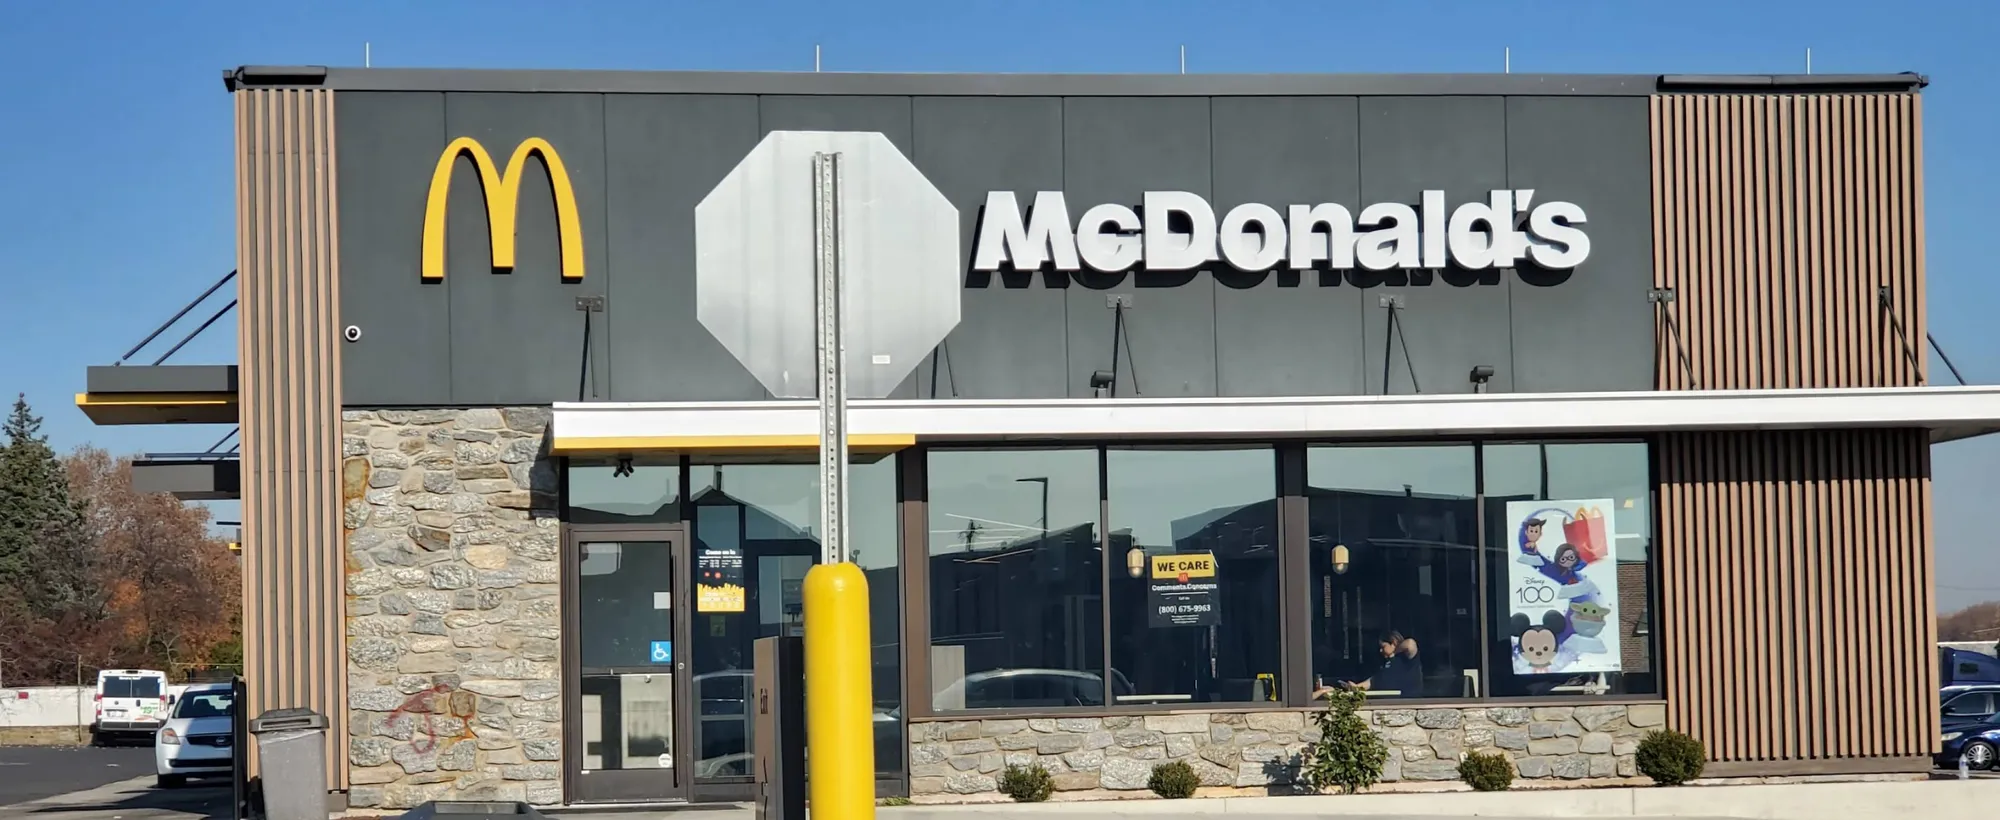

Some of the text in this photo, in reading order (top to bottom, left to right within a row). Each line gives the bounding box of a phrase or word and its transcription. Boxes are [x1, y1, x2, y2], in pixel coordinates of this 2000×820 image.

[974, 189, 1591, 272] McDonald's
[1157, 560, 1210, 572] WE CARE
[1523, 576, 1545, 585] Disney
[1515, 585, 1555, 604] 100
[1158, 605, 1177, 615] (800)
